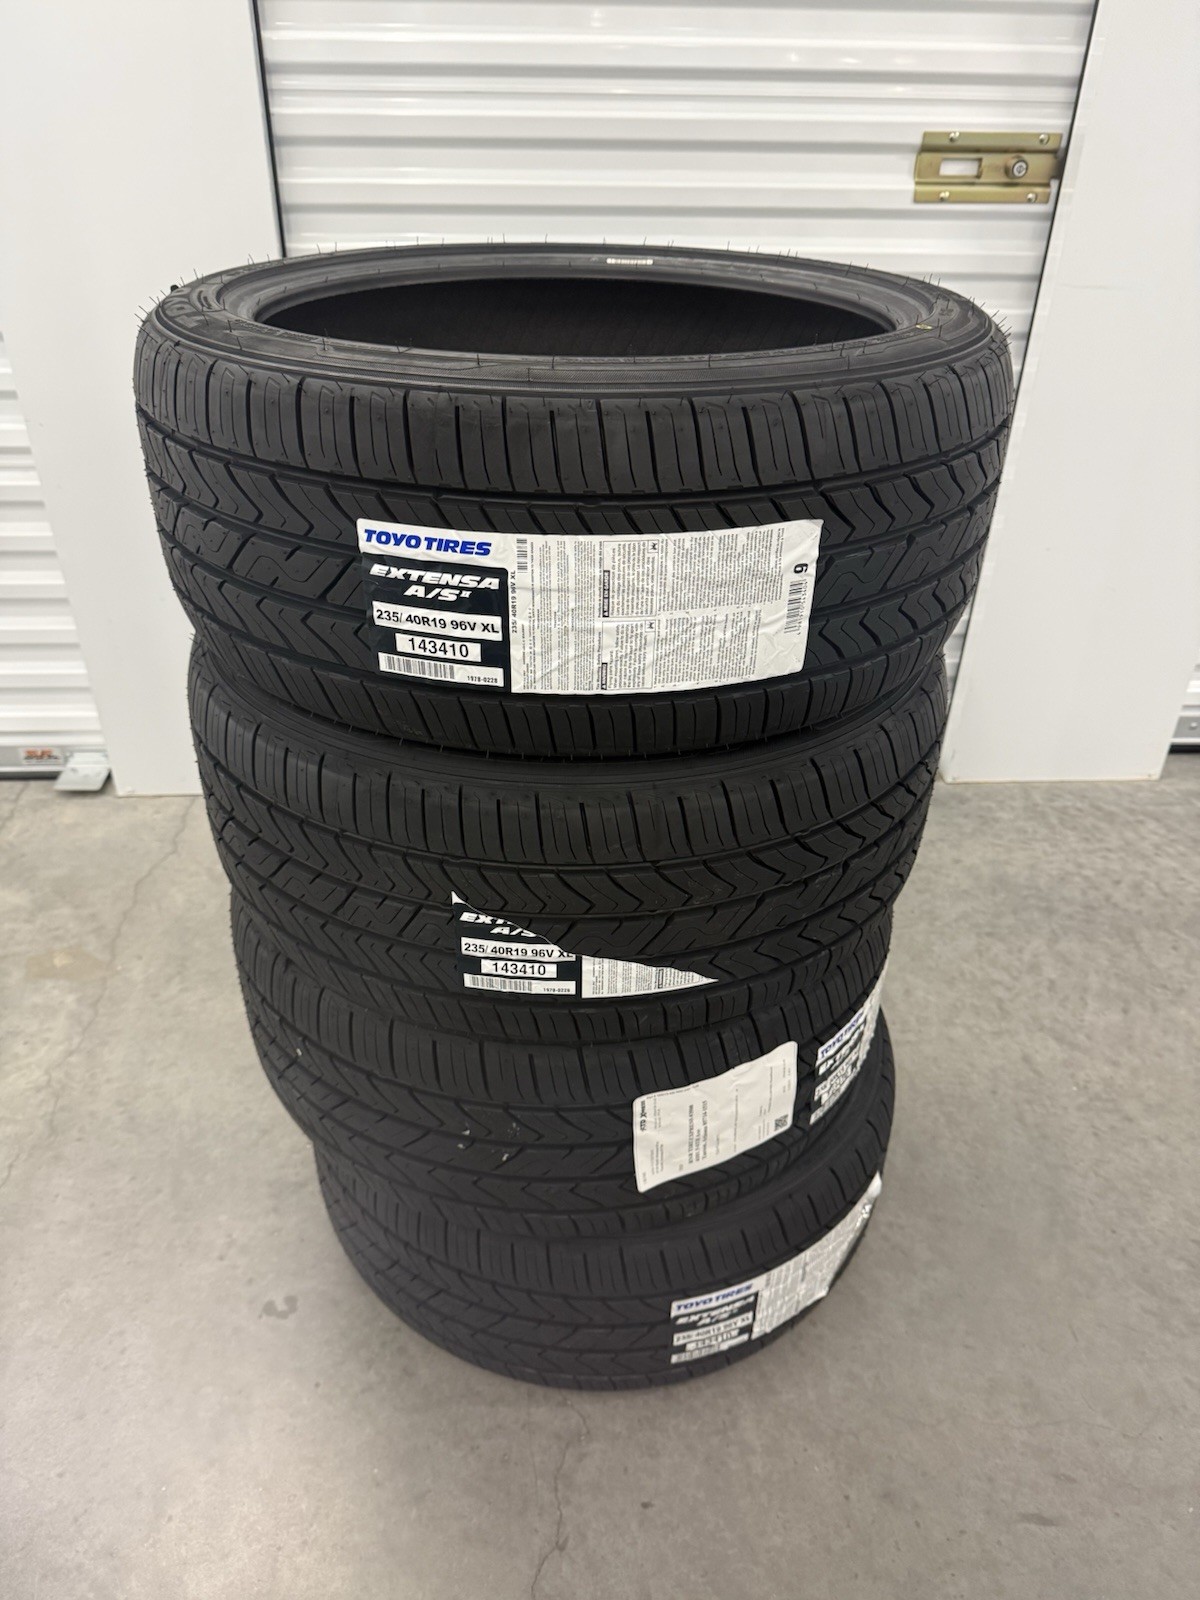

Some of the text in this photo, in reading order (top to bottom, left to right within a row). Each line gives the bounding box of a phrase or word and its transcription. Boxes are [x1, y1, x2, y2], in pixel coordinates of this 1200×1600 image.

[364, 529, 492, 556] TOYO TIRES
[369, 563, 500, 590] EXTENSA
[510, 570, 516, 580] XL
[794, 563, 808, 574] 9
[405, 614, 447, 629] 40R19
[450, 620, 477, 631] 96V
[481, 623, 500, 634] XL
[408, 637, 469, 658] 143410
[491, 946, 528, 956] 40R19
[531, 949, 554, 958] 96V
[492, 962, 547, 976] 143410
[676, 1283, 753, 1310] TOYO TIRES
